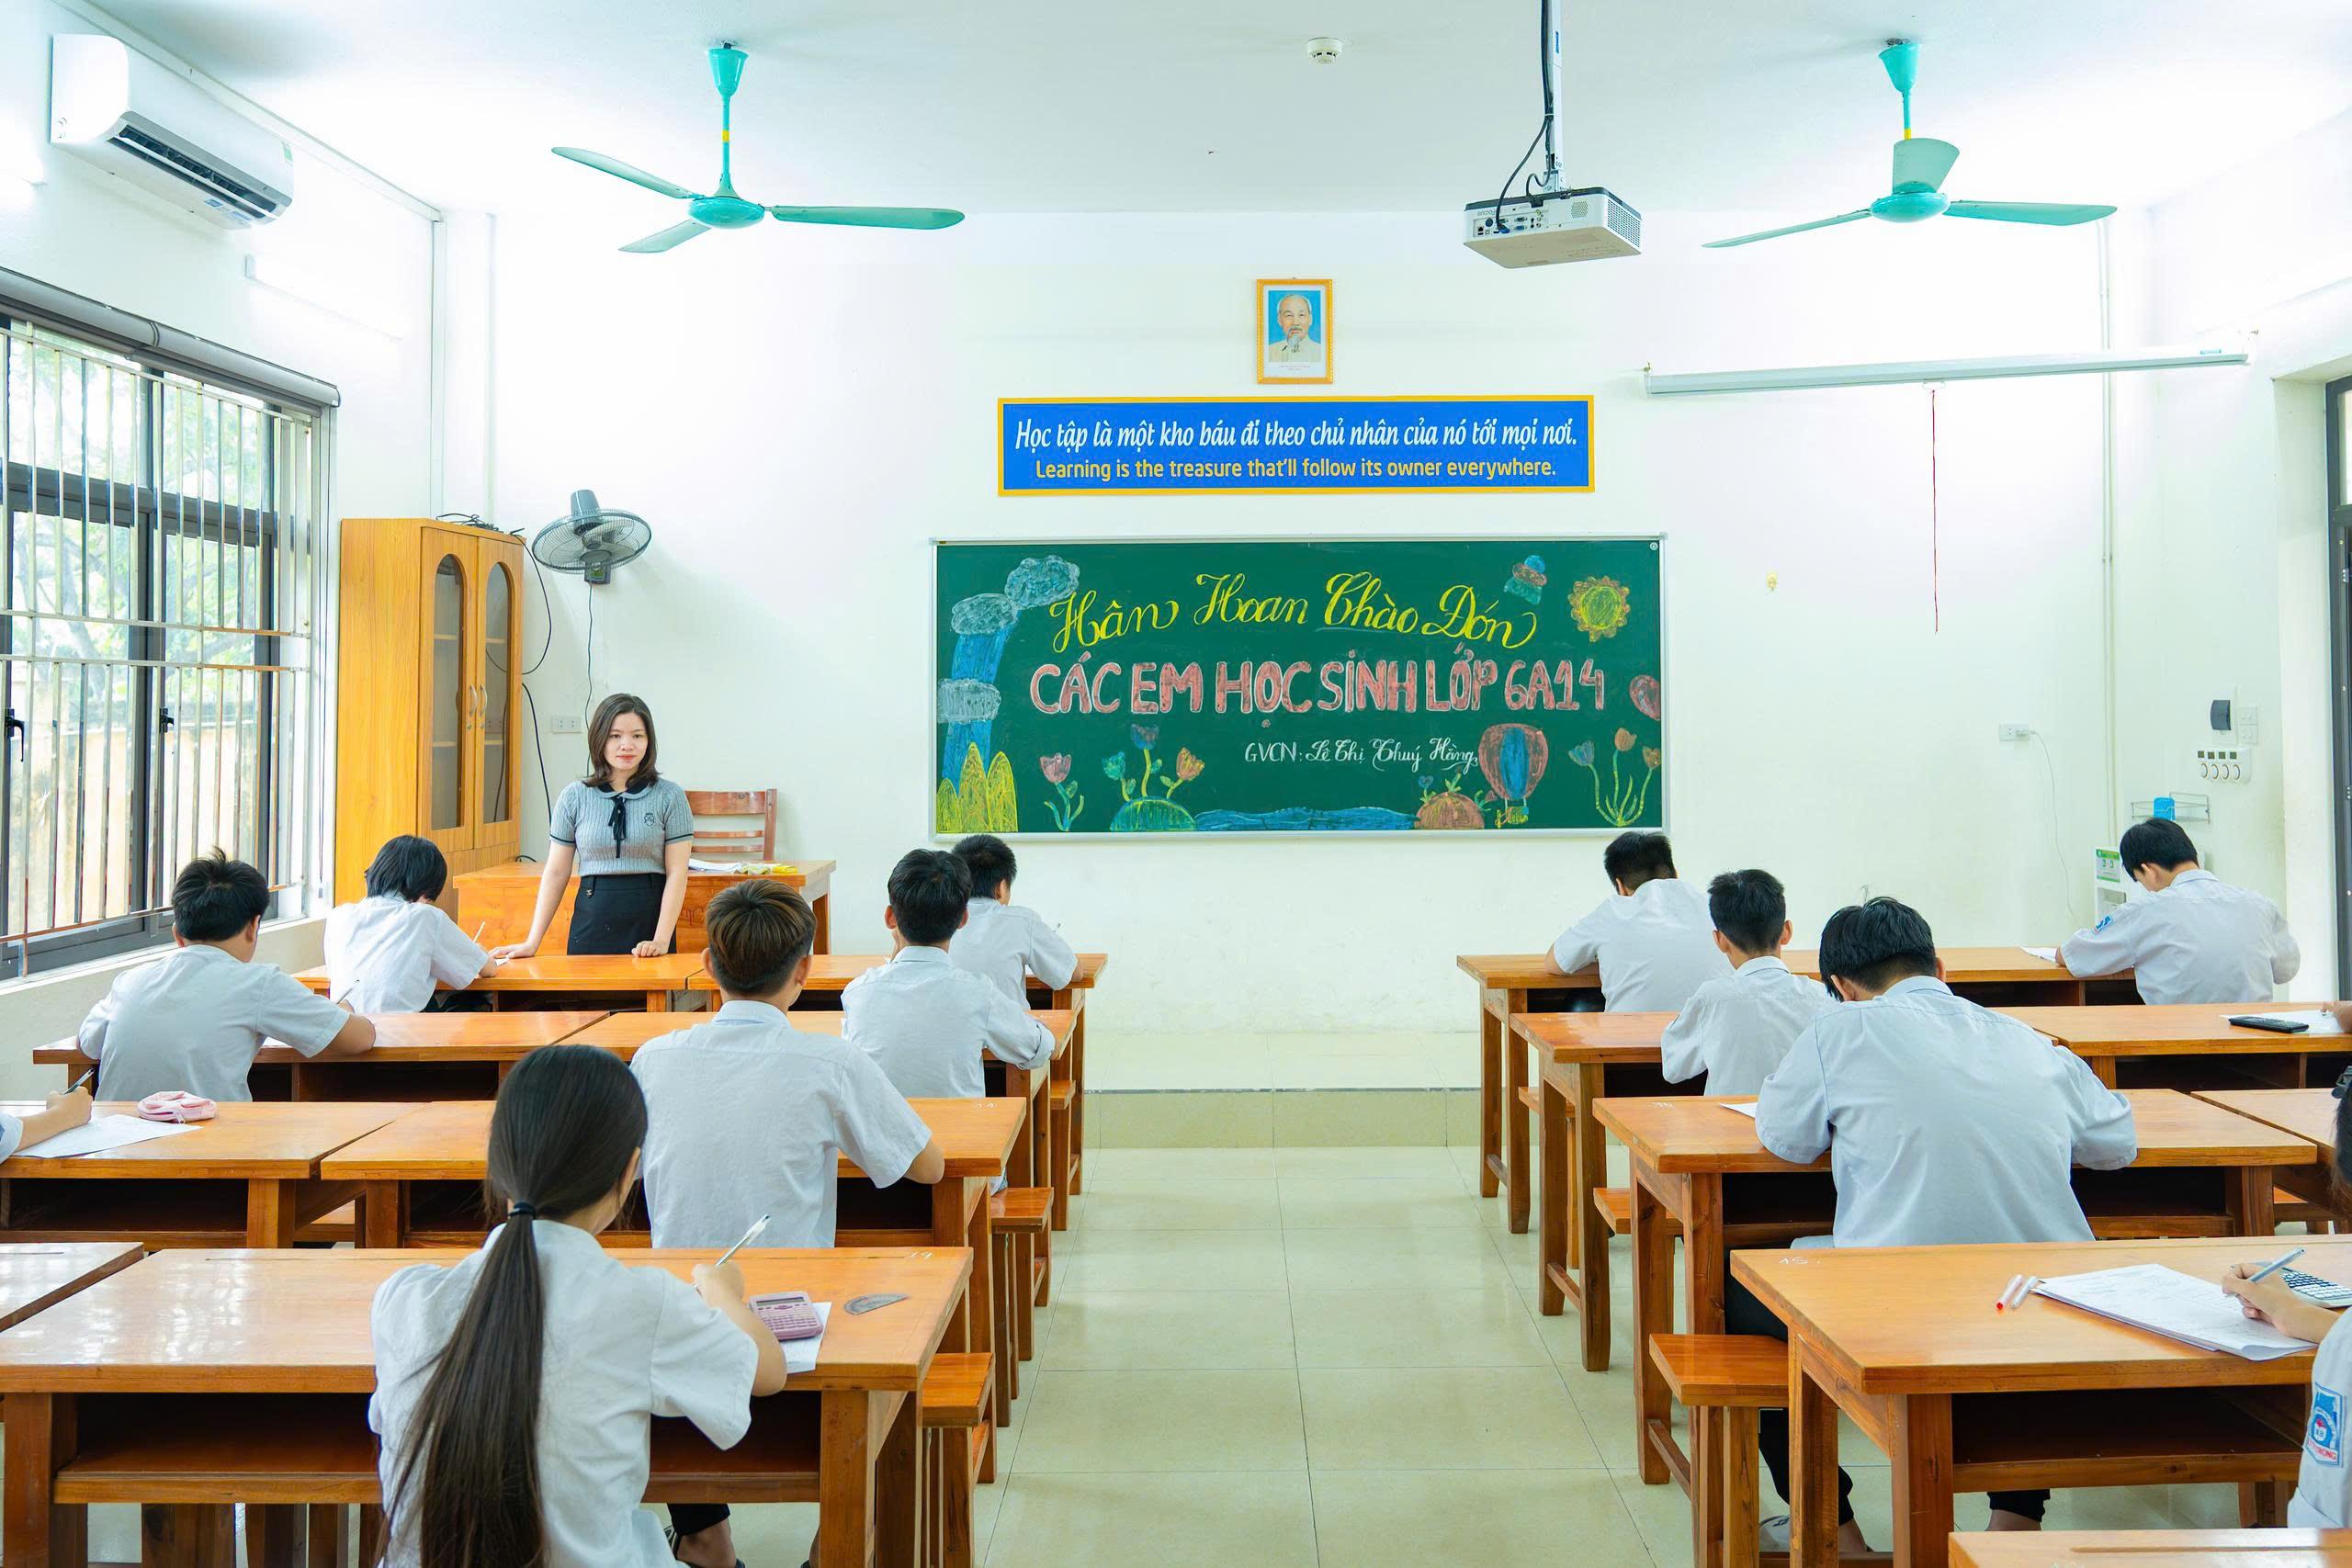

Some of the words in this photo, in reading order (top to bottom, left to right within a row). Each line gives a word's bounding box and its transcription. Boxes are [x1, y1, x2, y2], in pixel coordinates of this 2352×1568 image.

[1015, 419, 1051, 453] Học
[1057, 420, 1088, 453] tập
[1093, 420, 1112, 446] là
[1117, 420, 1155, 452] một
[1159, 421, 1194, 446] kho
[1199, 420, 1236, 446] báu
[1240, 419, 1260, 446] đi
[1265, 420, 1306, 446] theo
[1310, 417, 1345, 446] chủ
[1350, 419, 1398, 446] nhân
[1404, 417, 1437, 446] của
[1442, 418, 1466, 446] nó
[1472, 418, 1498, 446] tới
[1501, 418, 1538, 451] mọi
[1543, 418, 1577, 446] nơi.
[1036, 460, 1111, 481] Learning
[1116, 459, 1130, 478] is
[1136, 460, 1163, 478] the
[1170, 460, 1242, 478] treasure
[1248, 458, 1297, 477] that'll
[1302, 458, 1356, 477] follow
[1361, 458, 1382, 476] its
[1386, 461, 1442, 476] owner
[1447, 458, 1556, 480] everywhere.
[1049, 590, 1179, 653] Hân
[1194, 573, 1309, 625] Hoan
[1324, 571, 1419, 633] Chào
[1421, 584, 1537, 649] Đón
[1030, 651, 1122, 714] CÁC
[1131, 661, 1204, 715] EM
[1215, 660, 1313, 728] HỌC
[1425, 641, 1498, 711] LỚP
[1504, 659, 1604, 711] 6A14
[1244, 741, 1303, 762] GVCN:
[1306, 739, 1331, 762] Lê
[1335, 739, 1365, 763] Thị
